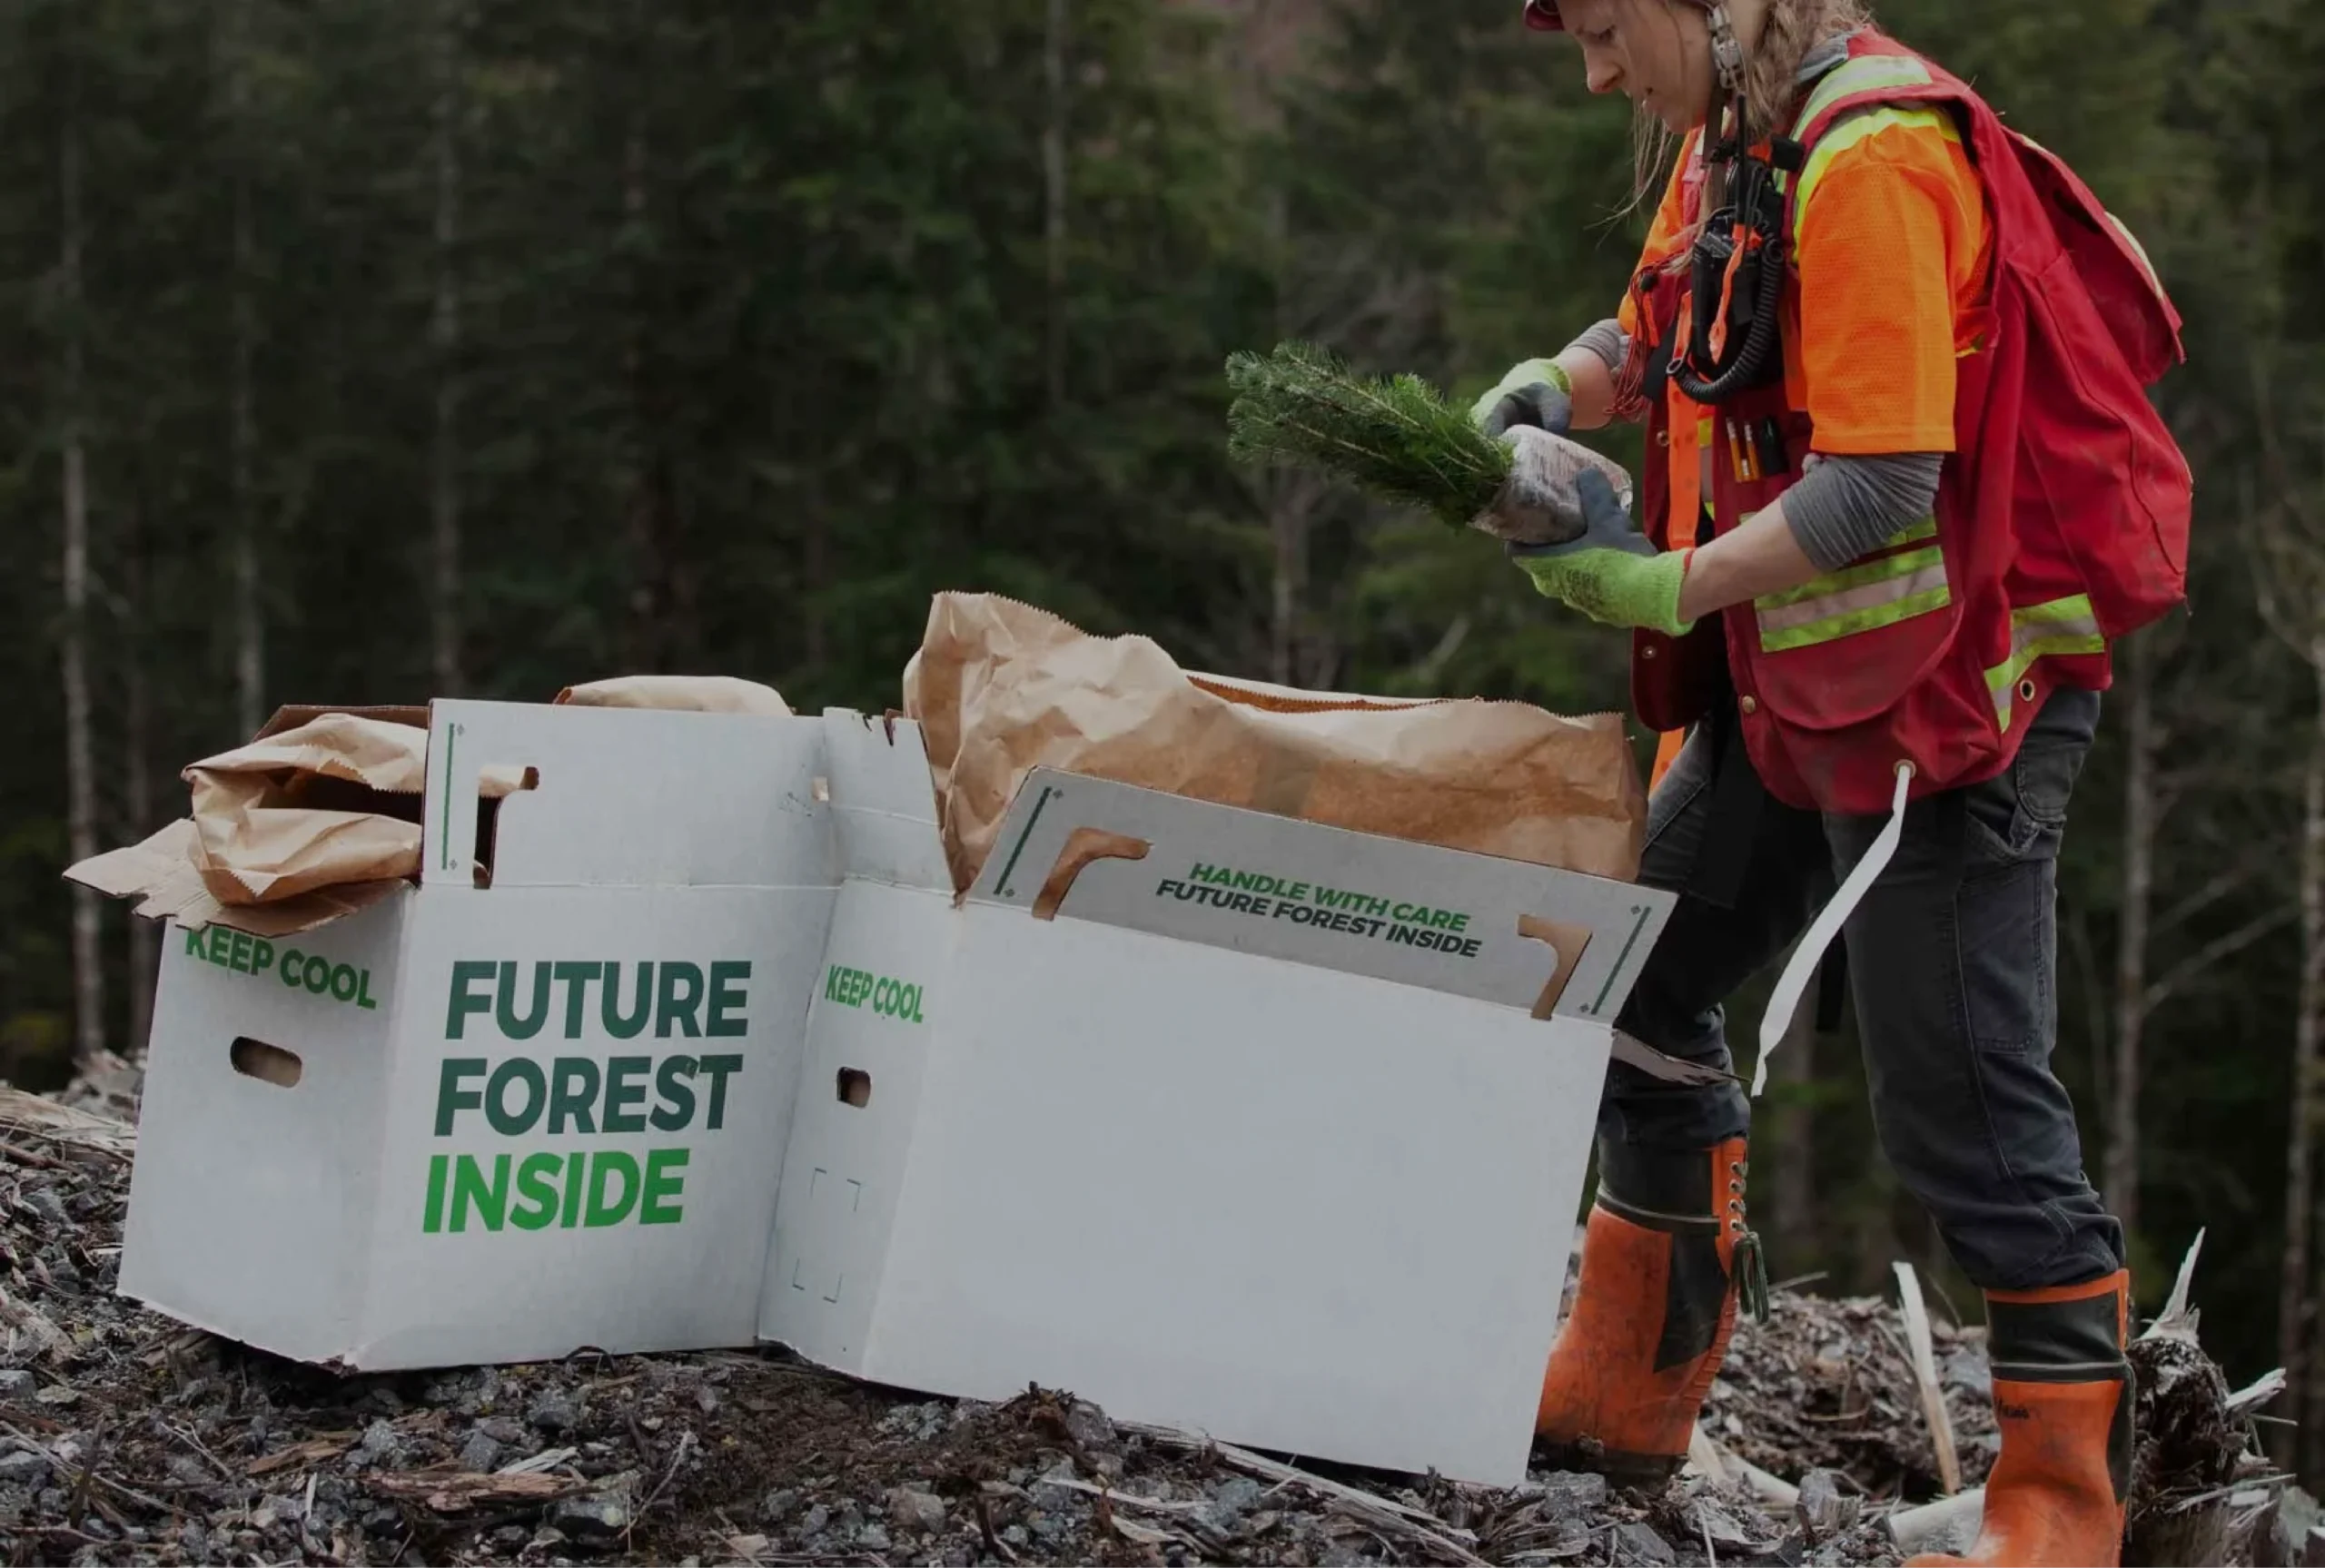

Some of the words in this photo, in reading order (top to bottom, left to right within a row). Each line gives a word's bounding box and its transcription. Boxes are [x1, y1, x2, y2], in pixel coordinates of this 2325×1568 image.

[1155, 878, 1271, 916] FUTURE
[1273, 901, 1387, 939] FOREST
[1385, 923, 1482, 958] INSIDE
[1189, 863, 1310, 901] HANDLE
[1315, 885, 1390, 917] WITH
[1392, 902, 1470, 932] CARE
[185, 926, 274, 976] KEEP
[280, 949, 377, 1010] COOL
[445, 960, 752, 1040] FUTURE
[825, 965, 874, 1009] KEEP
[873, 977, 924, 1024] COOL
[434, 1054, 743, 1137] FOREST
[422, 1149, 690, 1233] INSIDE
